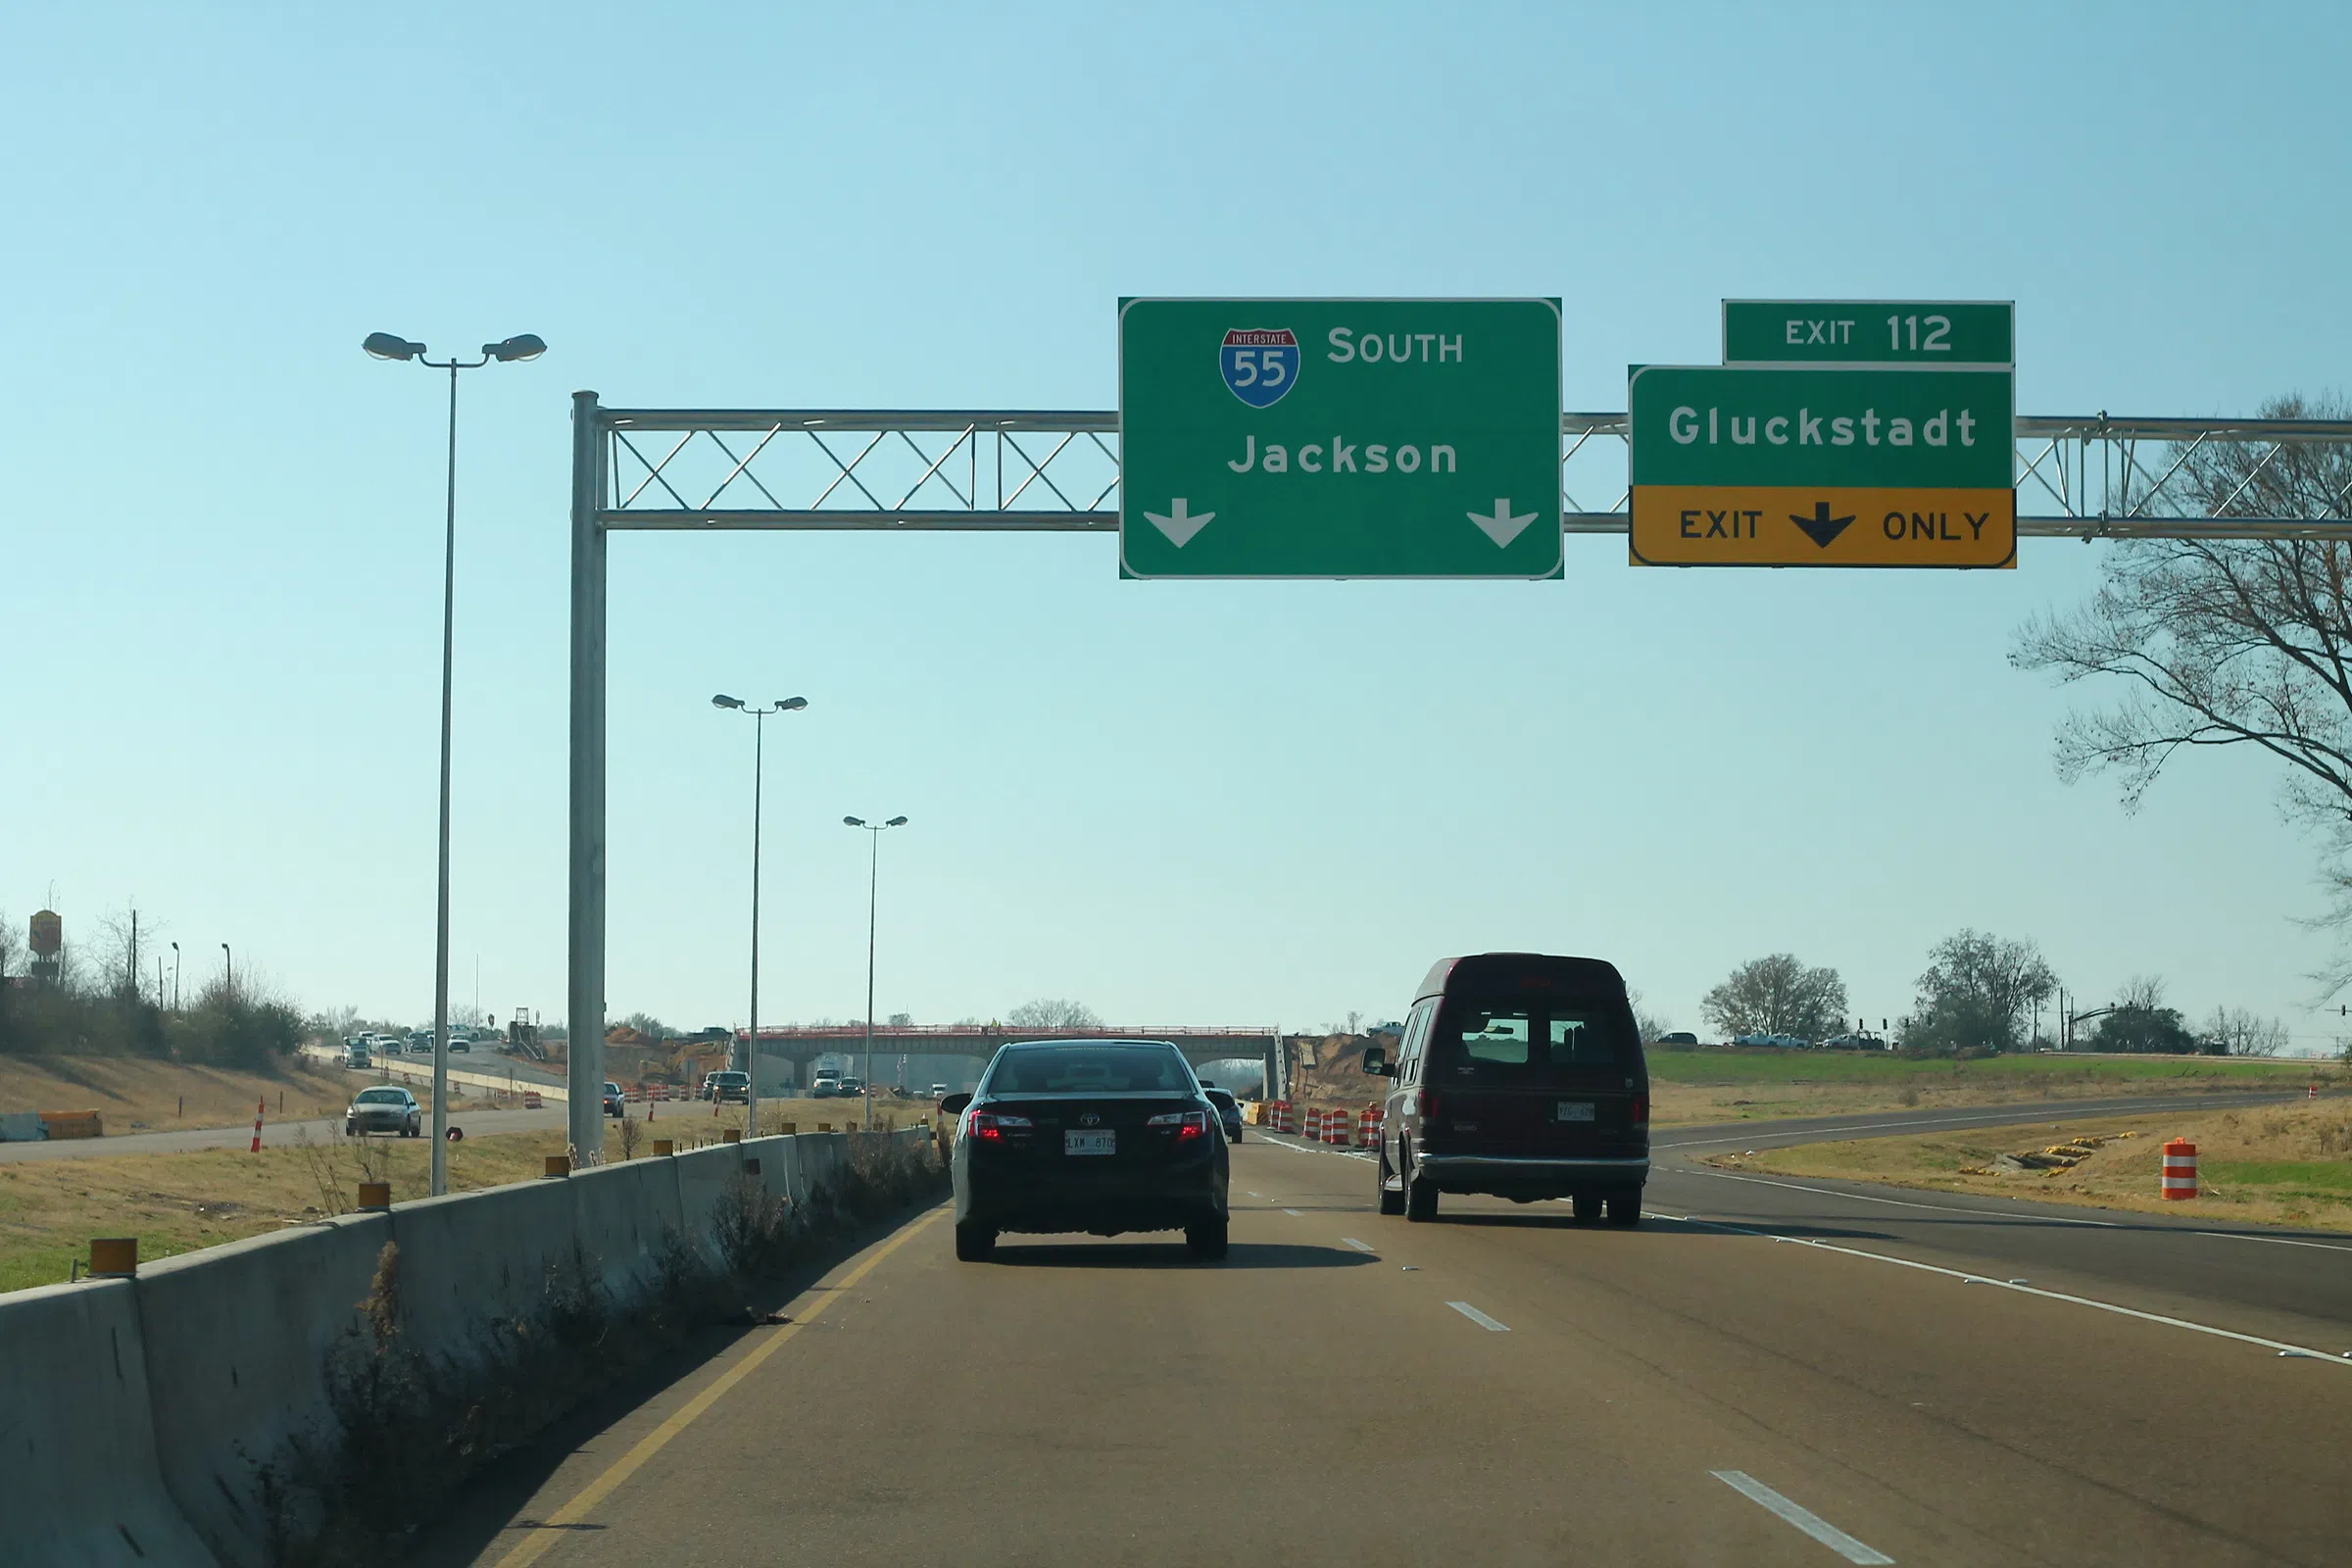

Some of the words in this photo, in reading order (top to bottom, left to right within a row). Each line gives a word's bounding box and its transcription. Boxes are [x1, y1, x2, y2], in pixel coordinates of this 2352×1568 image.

[1232, 334, 1287, 345] INTERSTATE
[1326, 327, 1464, 363] SOUTH
[1786, 319, 1855, 345] EXIT
[1886, 315, 1951, 351] 112
[1234, 351, 1286, 387] 55
[1669, 406, 1977, 447] Gluckstadt
[1227, 434, 1457, 472] Jackson
[1680, 510, 1763, 538] EXIT
[1883, 512, 1990, 541] ONLY
[1096, 1137, 1112, 1148] 870
